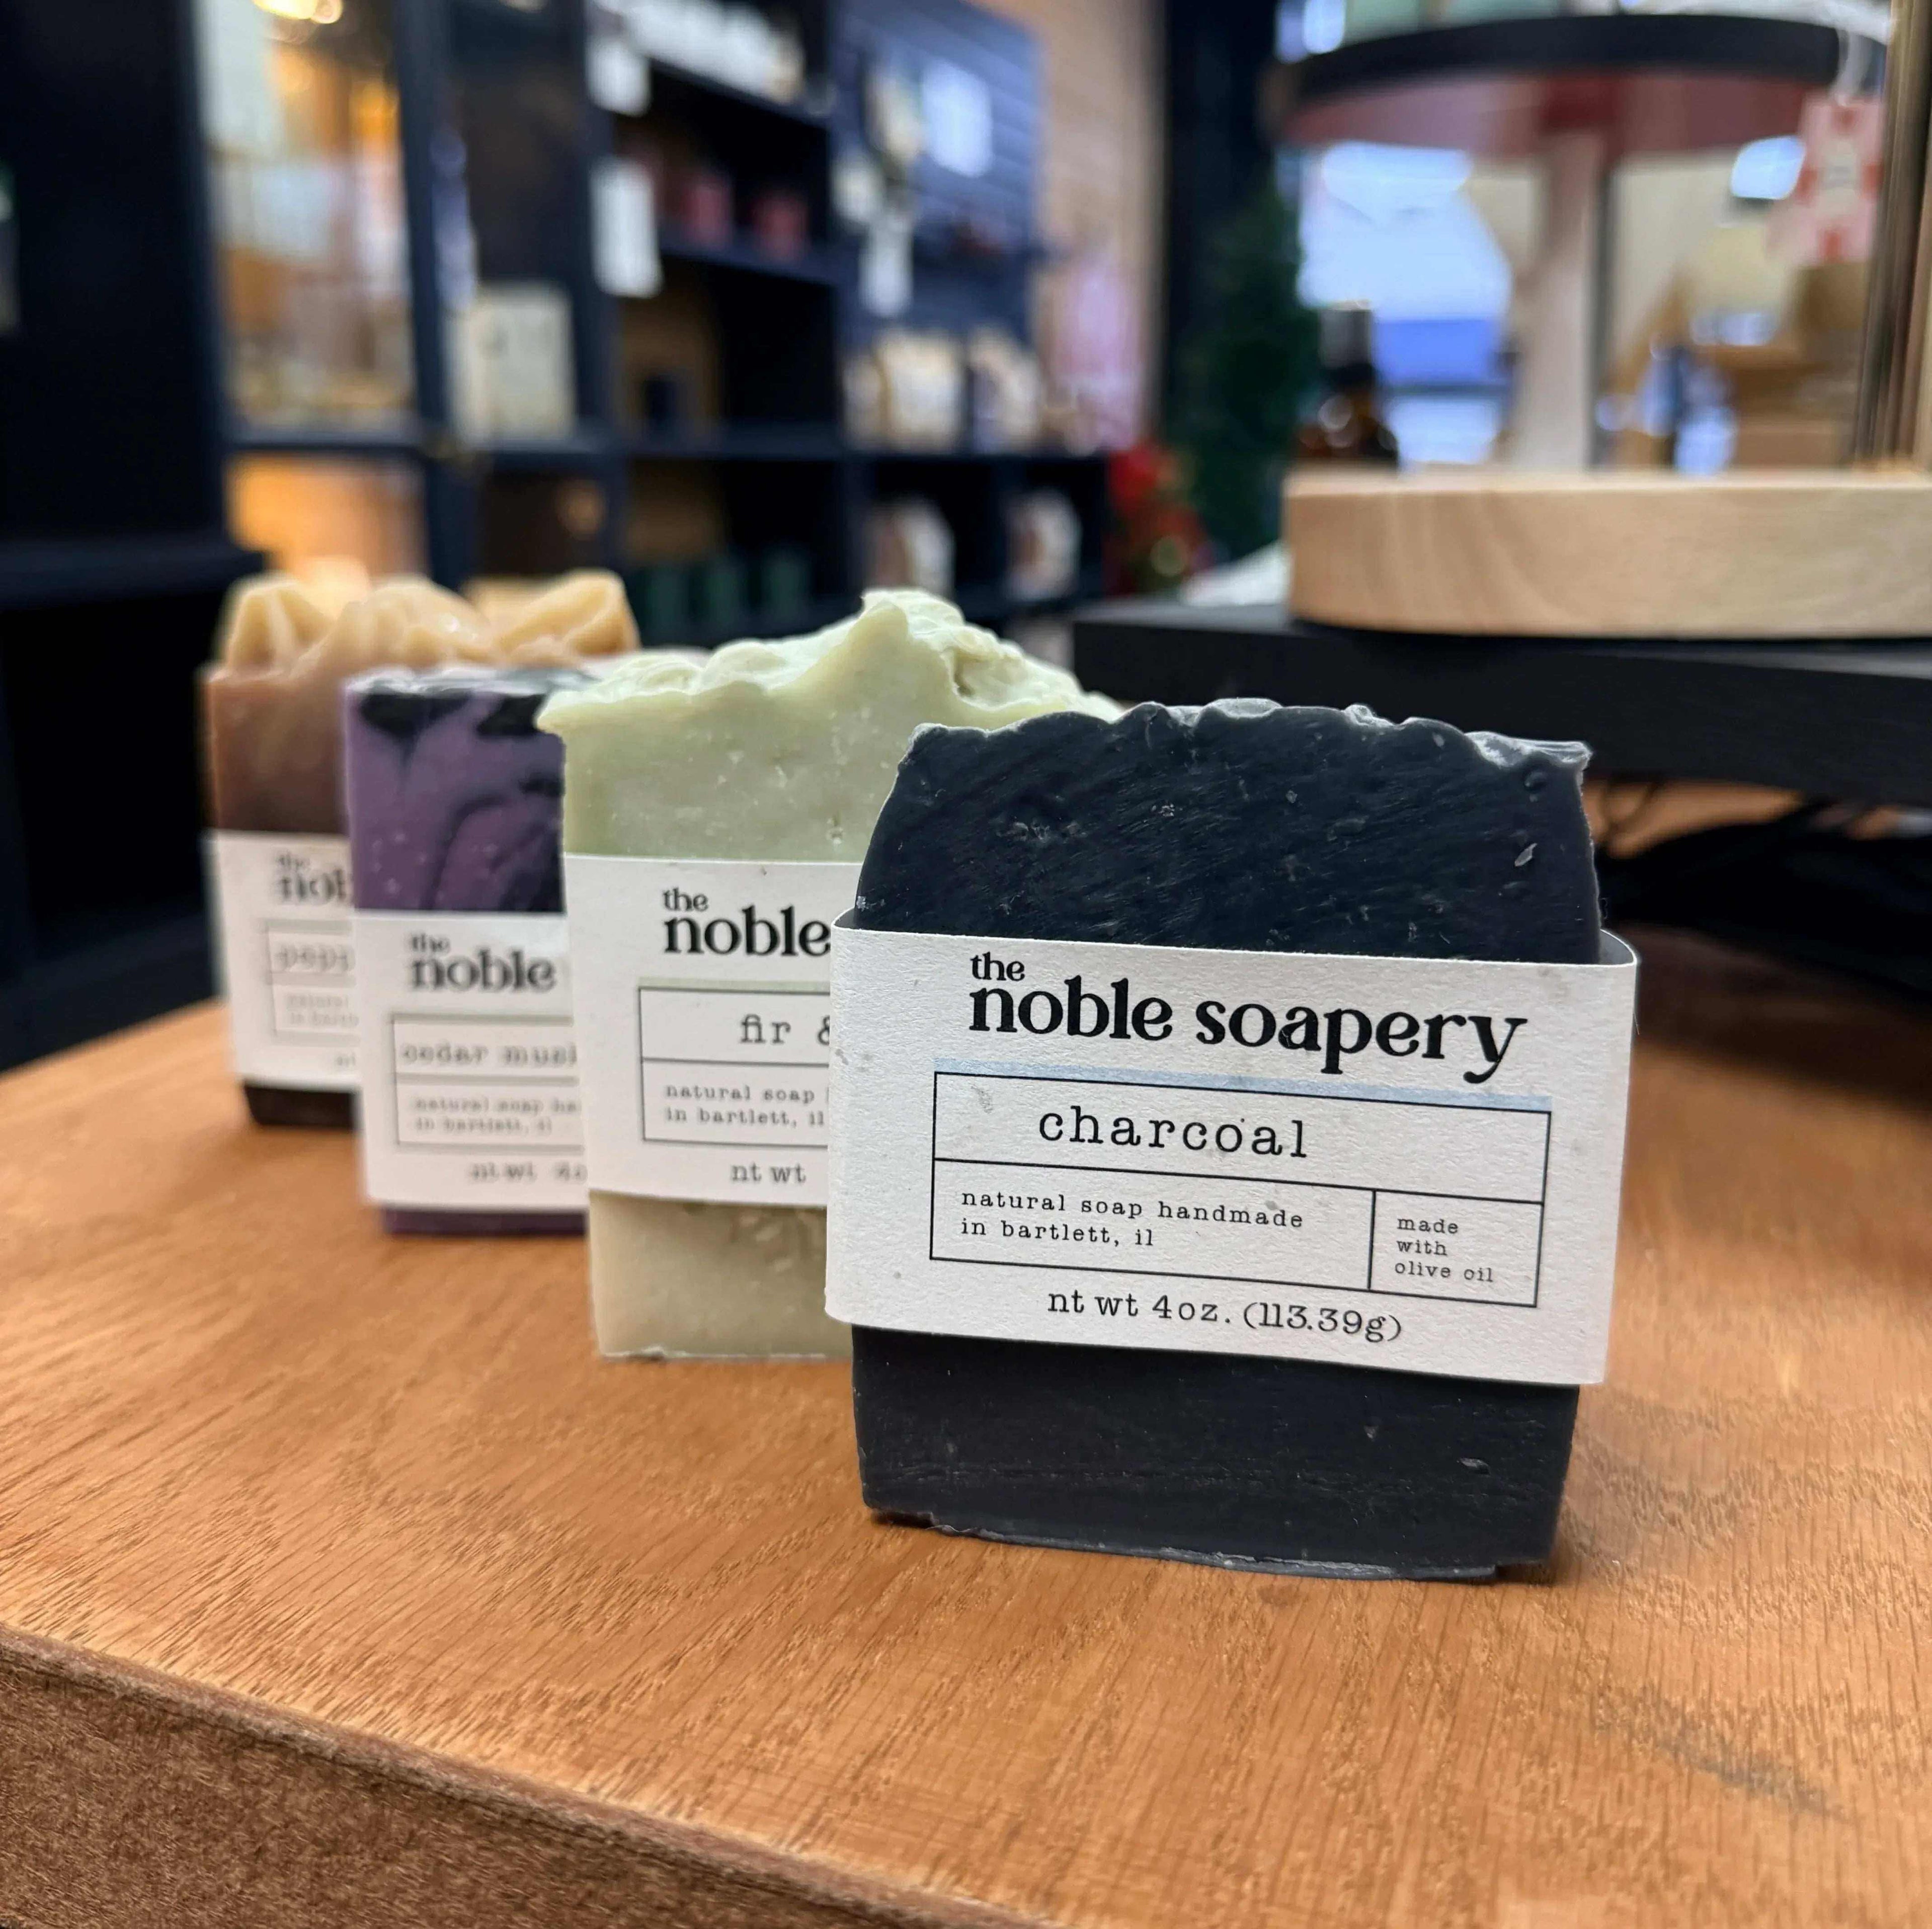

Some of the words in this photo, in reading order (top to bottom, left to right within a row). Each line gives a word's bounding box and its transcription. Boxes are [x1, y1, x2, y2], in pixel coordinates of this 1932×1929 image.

[663, 888, 708, 912] the
[410, 932, 450, 952] the
[664, 906, 830, 956] noble
[412, 947, 555, 992] noble
[970, 951, 1025, 982] the
[741, 1014, 791, 1044] fir
[969, 976, 1173, 1041] noble
[1195, 1000, 1528, 1084] soapery
[666, 1085, 750, 1100] natural
[763, 1090, 815, 1104] soap
[667, 1107, 687, 1121] in
[699, 1108, 796, 1127] bartlett,
[809, 1111, 824, 1126] il
[1039, 1105, 1307, 1158] charcoal
[732, 1163, 762, 1182] nt
[770, 1165, 806, 1183] wt
[961, 1191, 1065, 1211] natural
[1081, 1200, 1142, 1219] soap
[1158, 1200, 1303, 1228] handmade
[961, 1218, 986, 1236] in
[1001, 1220, 1119, 1247] bartlett,
[1135, 1229, 1153, 1246] il
[1397, 1219, 1459, 1234] made
[1396, 1239, 1447, 1256] with
[1395, 1261, 1451, 1278] olive
[1464, 1267, 1493, 1283] oil
[1048, 1290, 1084, 1313] nt
[1094, 1293, 1138, 1317] wt
[1152, 1295, 1230, 1324] 4oz.
[1243, 1300, 1403, 1343] (113.39g)
